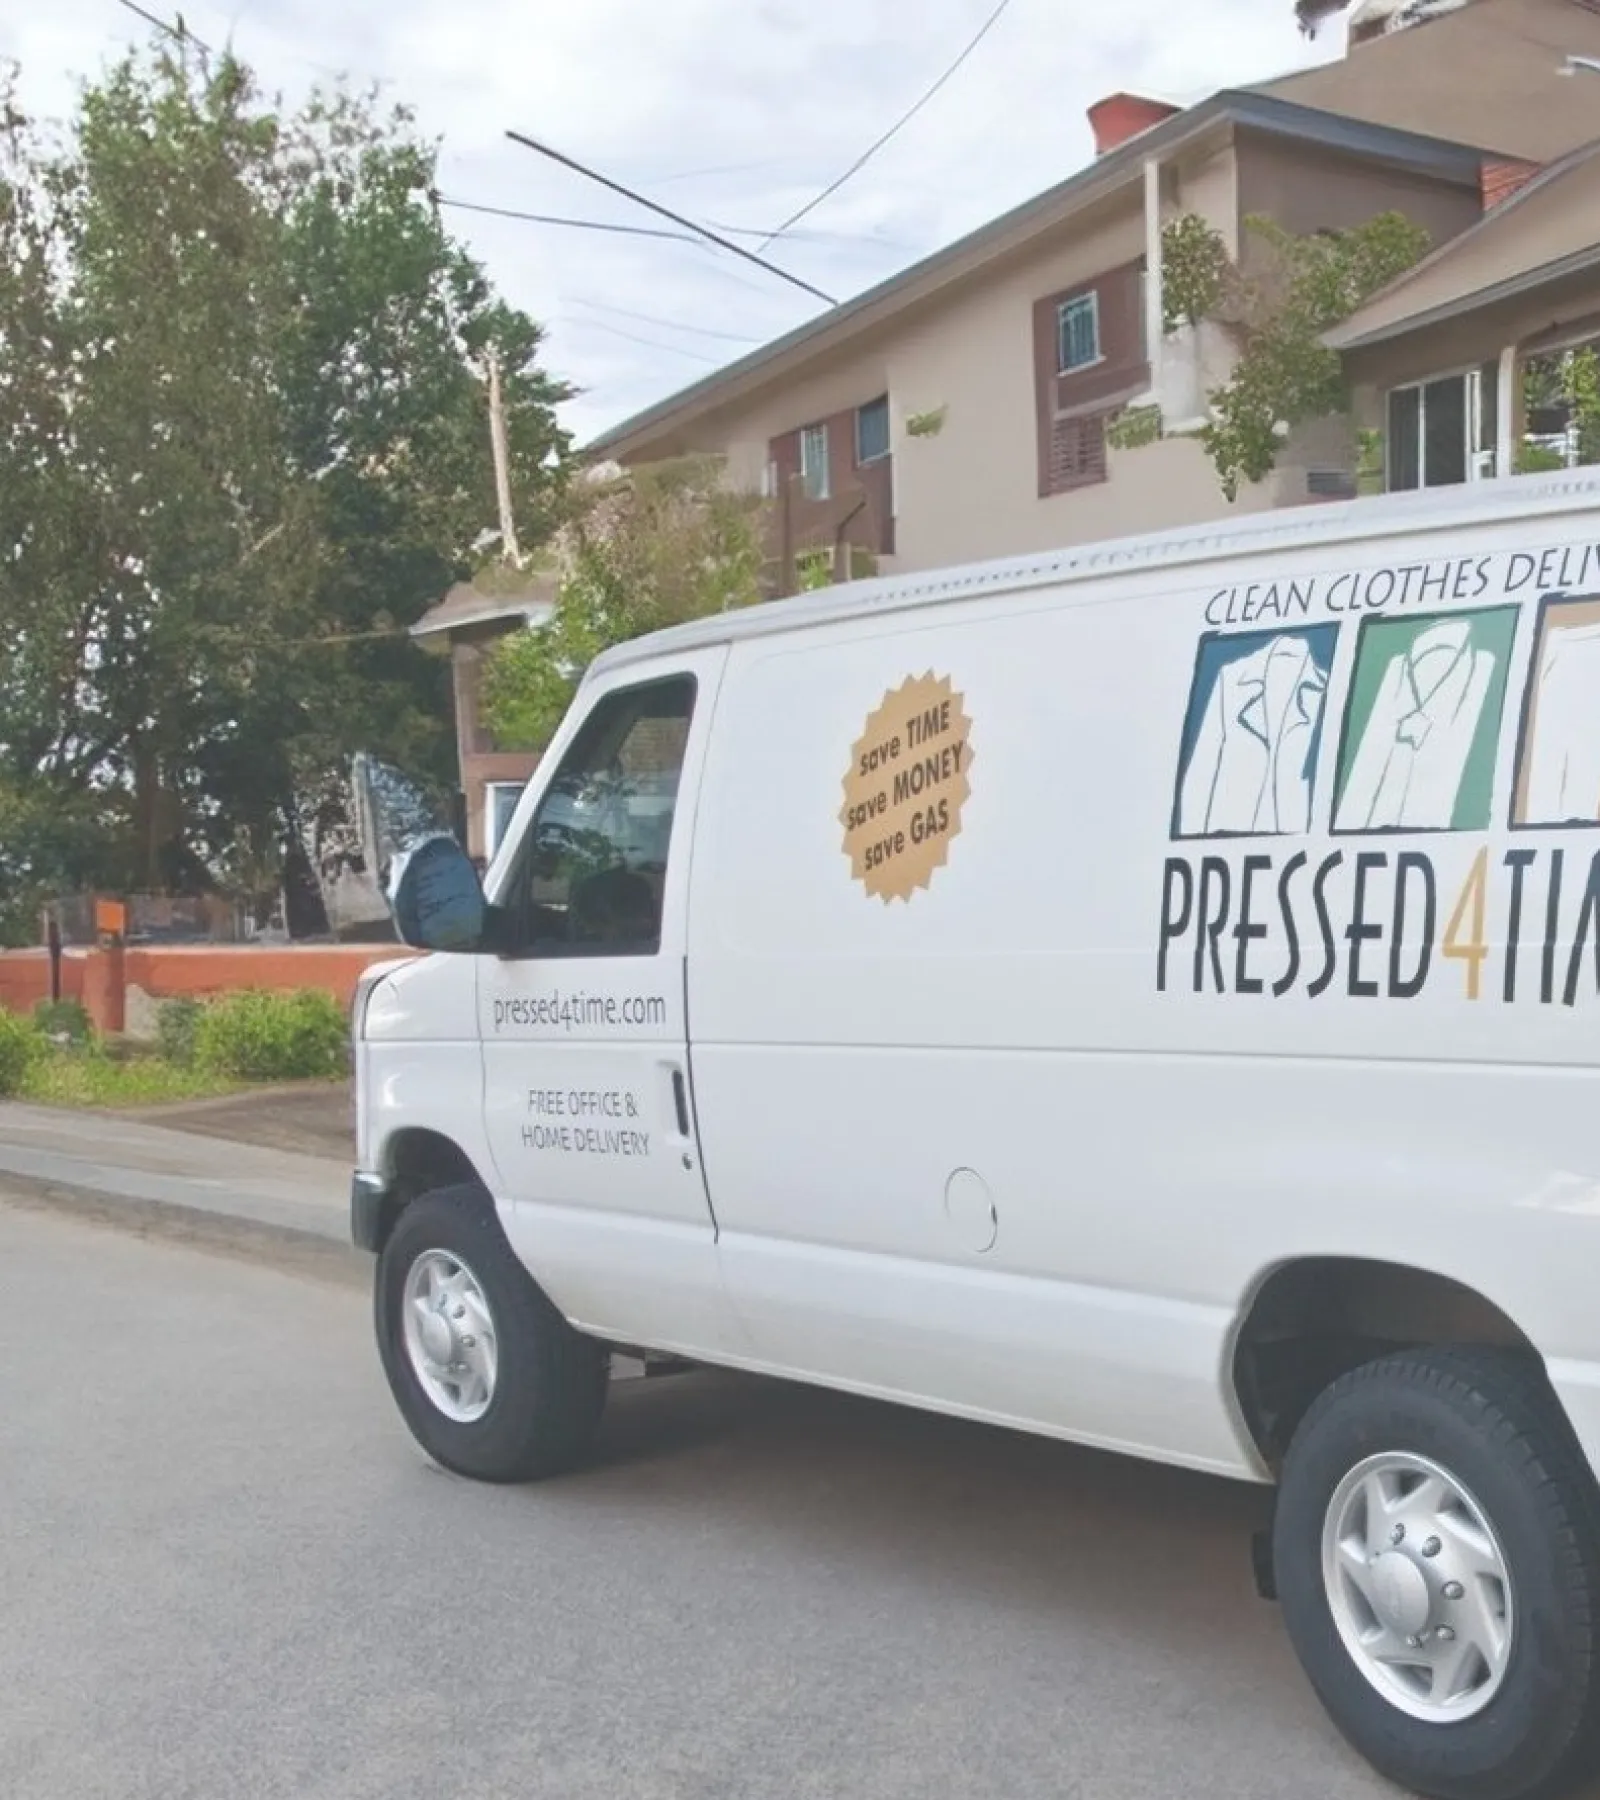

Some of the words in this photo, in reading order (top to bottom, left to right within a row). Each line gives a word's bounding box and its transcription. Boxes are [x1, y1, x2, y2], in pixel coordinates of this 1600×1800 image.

[1205, 579, 1316, 626] CLEAN
[1325, 555, 1491, 613] CLOTHES
[859, 735, 901, 777] save
[905, 699, 951, 749] TIME
[846, 791, 887, 832] save
[892, 739, 964, 806] MONEY
[864, 830, 905, 871] save
[909, 798, 950, 844] GAS
[493, 987, 666, 1033] pressed4time.com
[528, 1089, 565, 1116] FREE
[567, 1090, 622, 1117] OFFICE
[626, 1091, 639, 1118] &
[521, 1123, 571, 1151] HOME
[573, 1127, 650, 1156] DELIVERY
